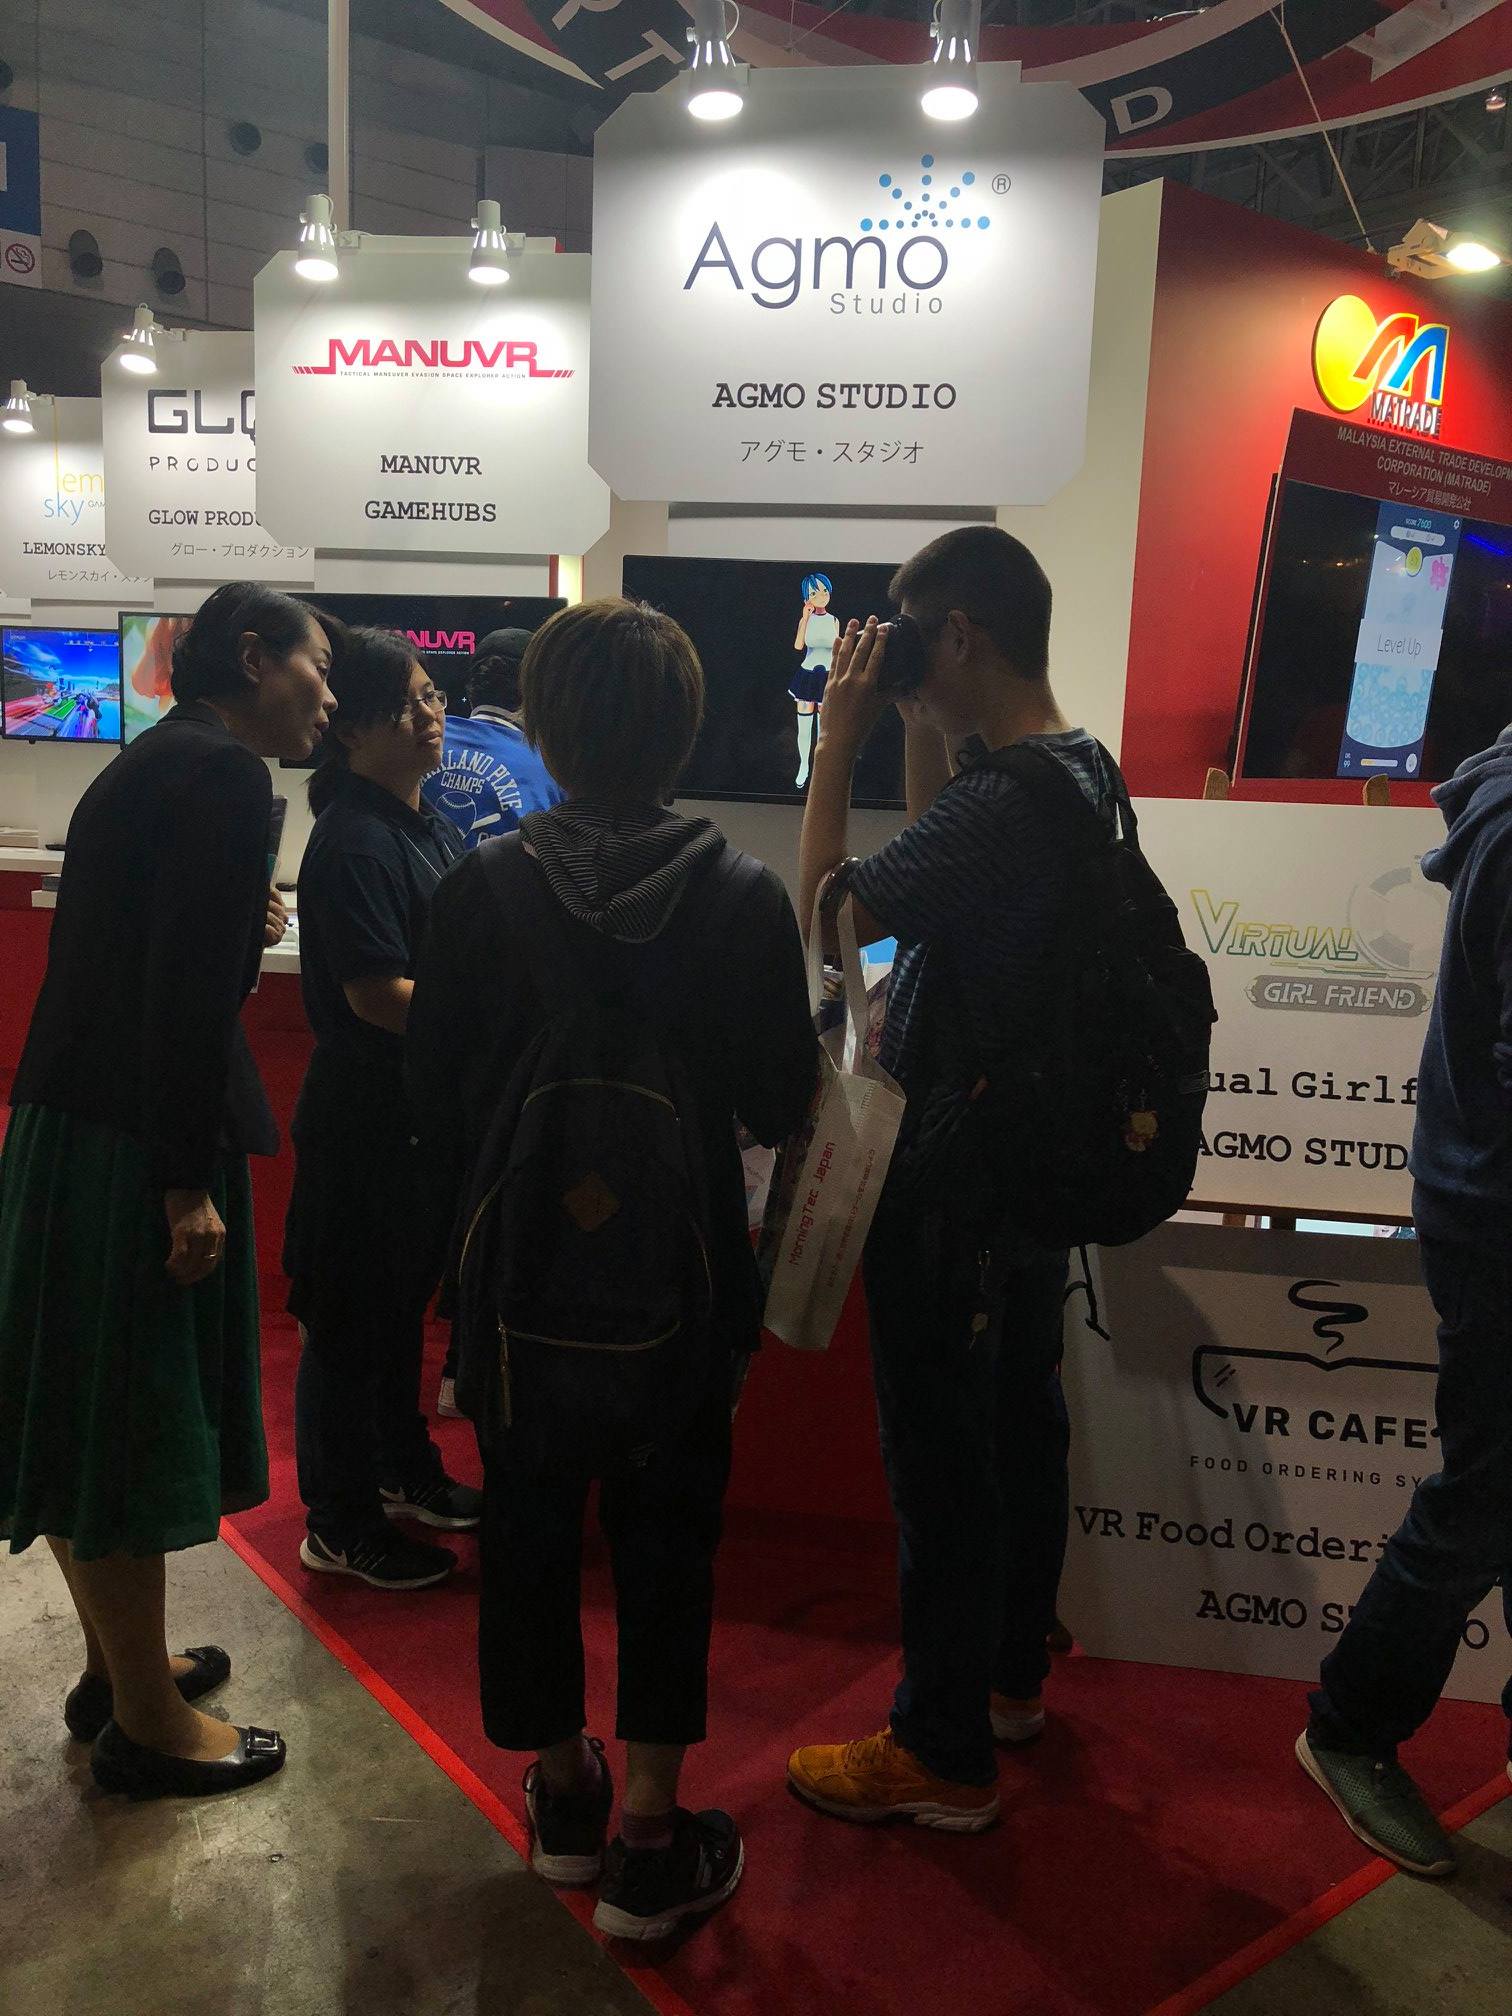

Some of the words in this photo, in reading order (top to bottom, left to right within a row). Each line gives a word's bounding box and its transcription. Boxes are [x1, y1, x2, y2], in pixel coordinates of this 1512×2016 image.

[683, 221, 948, 309] Agmo
[830, 292, 943, 314] Studio
[328, 339, 538, 377] MANUVR
[712, 382, 806, 409] AGMO
[816, 382, 957, 410] STUDIO
[1370, 392, 1442, 437] MATRADE
[741, 440, 924, 464] アグモ・スタジオ
[1337, 426, 1387, 450] MALAYSIA
[1388, 439, 1436, 464] EXTERNAL
[1438, 451, 1466, 470] TRADE
[380, 454, 482, 475] MANUVR
[1376, 456, 1443, 483] CORPORATION
[1443, 471, 1492, 496] (MATRADE)
[44, 492, 84, 526] sky
[148, 510, 199, 525] GLOW
[364, 500, 497, 522] GAMEHUBS
[23, 542, 106, 556] LEMONSKY
[170, 542, 310, 559] グロー・プロダクション
[1377, 634, 1406, 655] Level
[1408, 640, 1422, 657] Up
[441, 771, 486, 794] CHAMPS
[486, 764, 522, 812] PIXIE
[1264, 982, 1317, 1006] GIRL
[1324, 984, 1416, 1010] FRIEND
[1232, 1403, 1290, 1436] VR
[1308, 1410, 1428, 1449] CAFE
[1190, 1455, 1248, 1473] FOOD
[1262, 1462, 1381, 1485] ORDERING
[1075, 1506, 1126, 1538] VR
[1136, 1511, 1235, 1549] Food
[1196, 1590, 1307, 1629] AGMO
